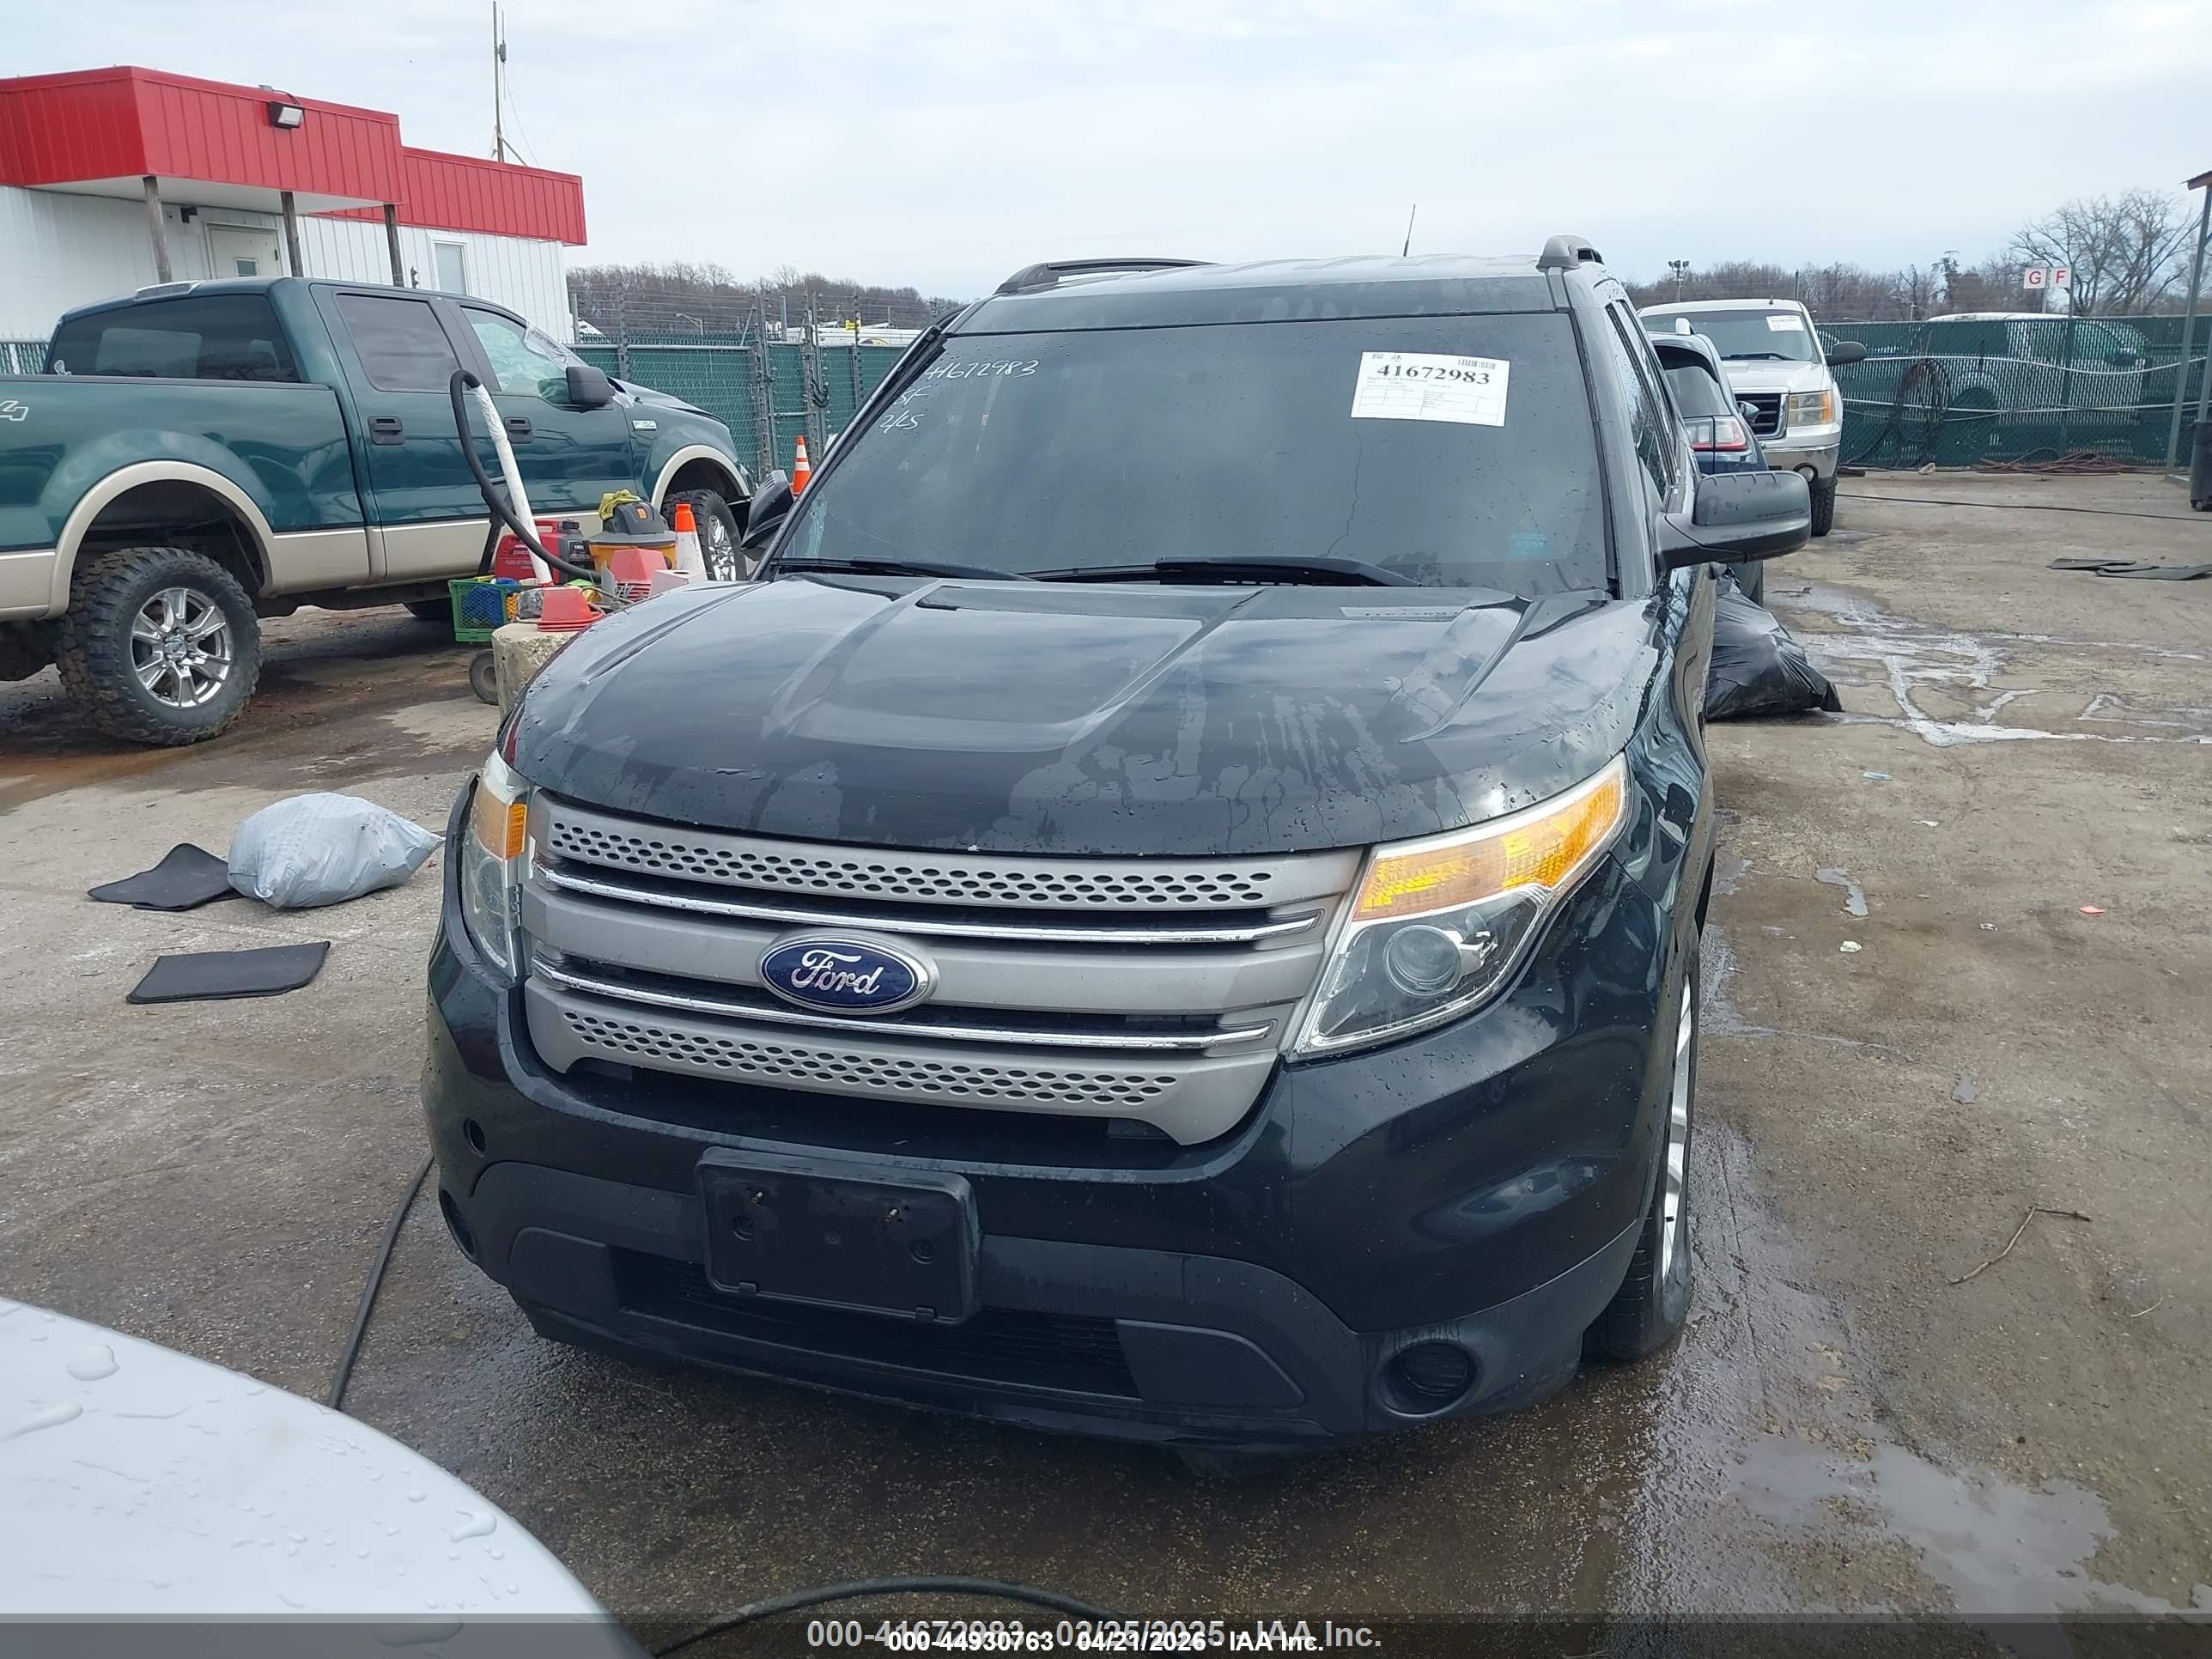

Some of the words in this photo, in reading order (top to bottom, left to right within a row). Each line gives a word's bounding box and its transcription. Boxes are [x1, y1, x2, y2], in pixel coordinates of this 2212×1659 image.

[2028, 270, 2042, 285] G
[2055, 270, 2067, 284] F
[924, 360, 1039, 380] 41672983
[1376, 364, 1491, 385] 41672983
[791, 950, 884, 995] Ford
